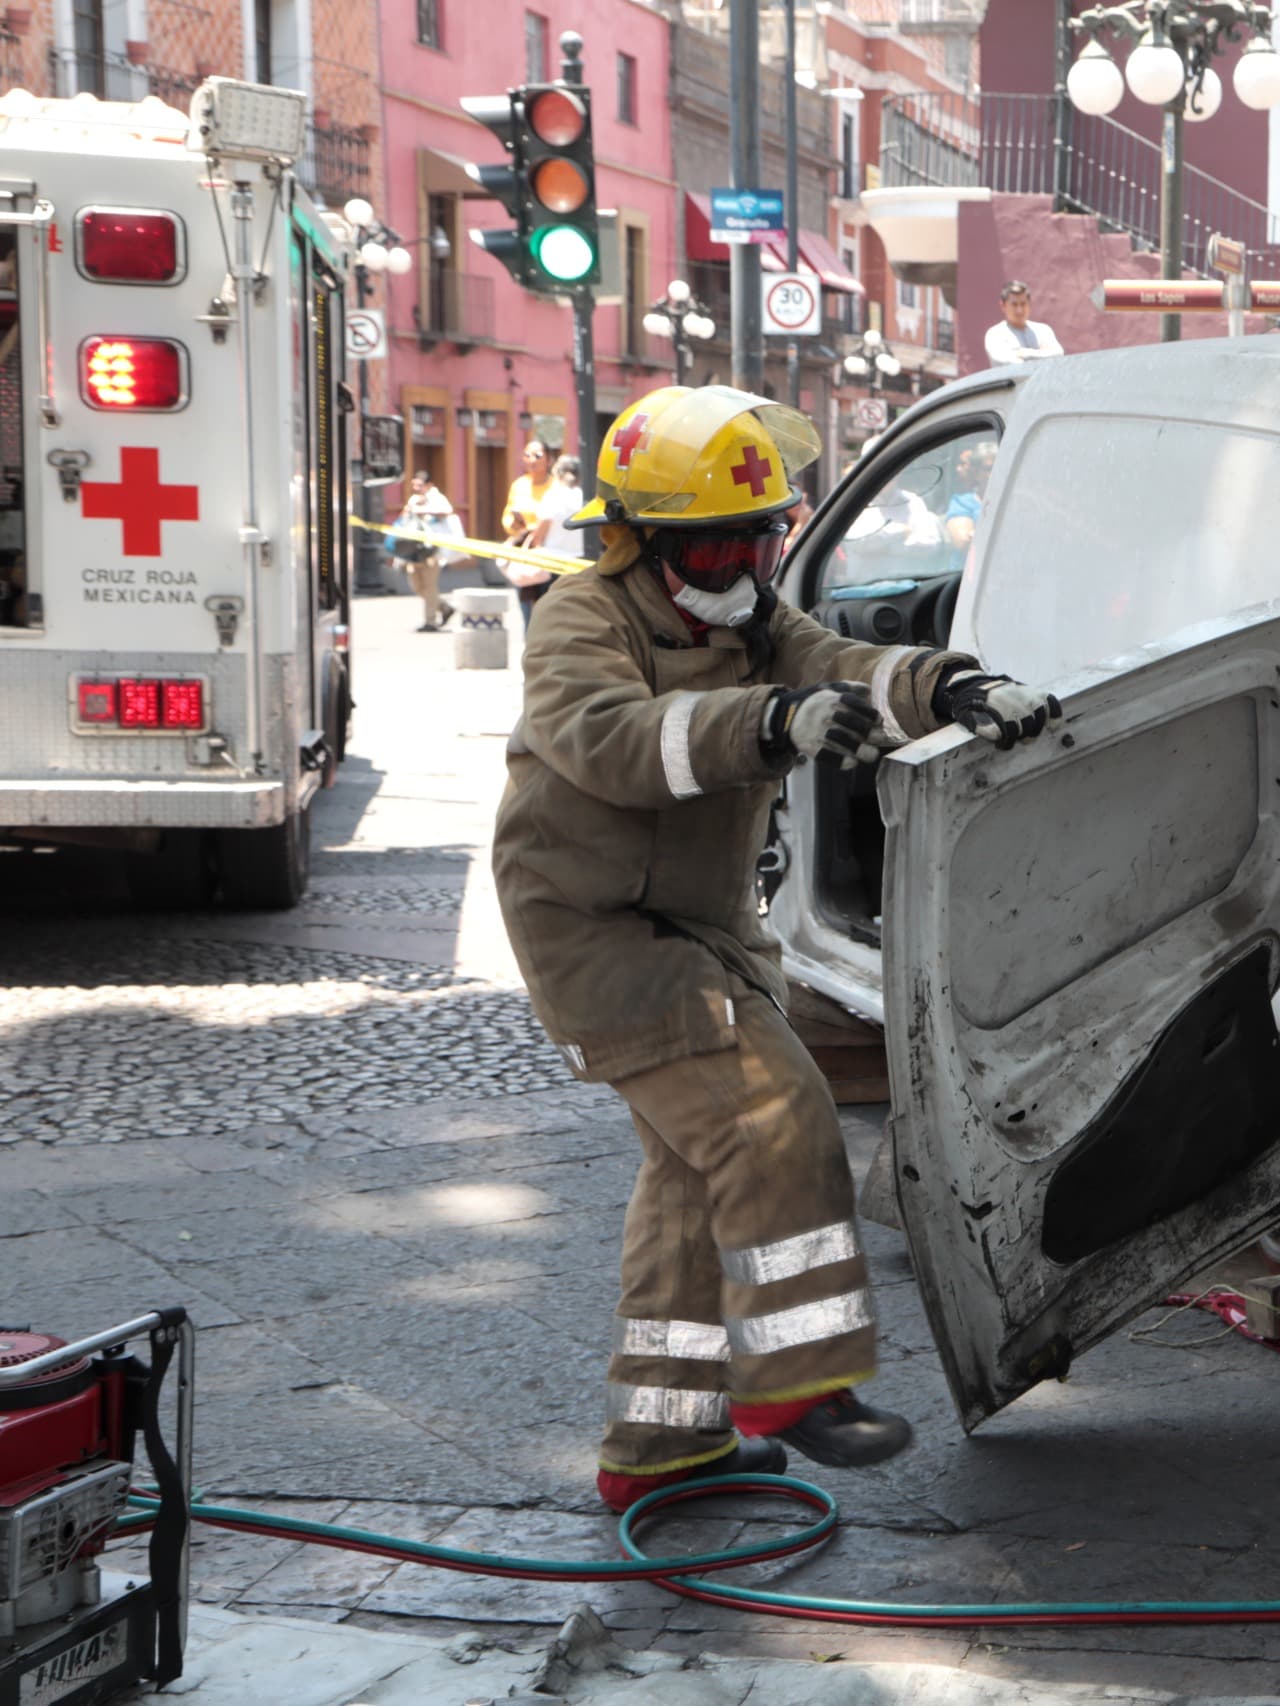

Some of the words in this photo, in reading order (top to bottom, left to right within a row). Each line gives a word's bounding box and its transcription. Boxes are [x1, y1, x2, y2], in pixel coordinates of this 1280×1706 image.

[779, 287, 804, 305] 30
[81, 568, 136, 584] CRUZ
[146, 570, 198, 585] ROJA
[83, 588, 197, 604] MEXICANA
